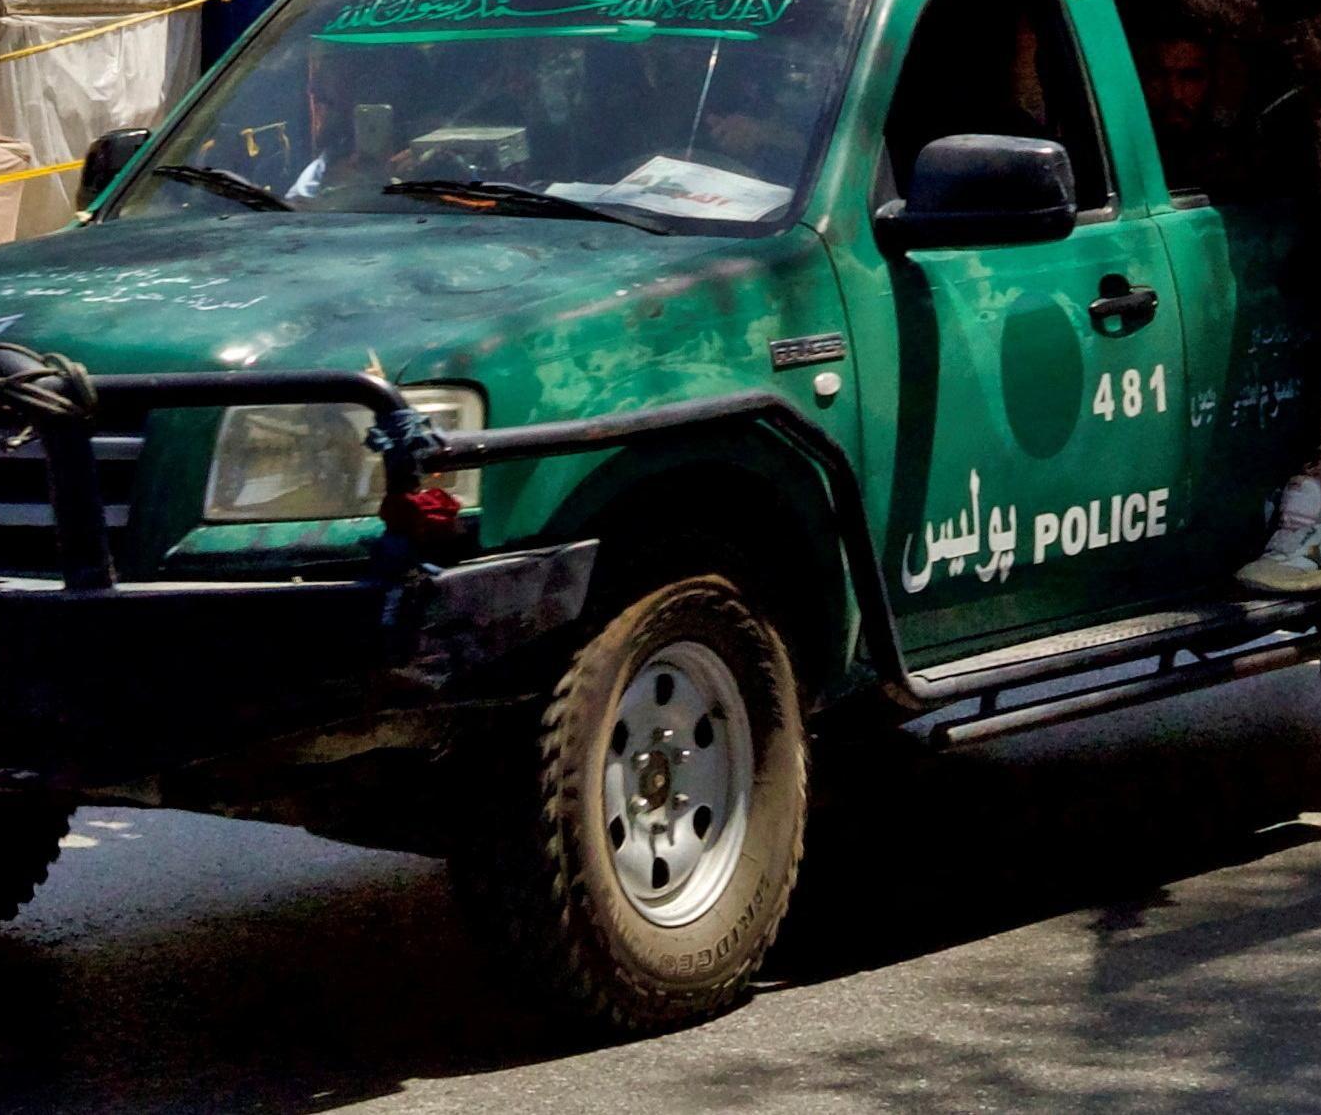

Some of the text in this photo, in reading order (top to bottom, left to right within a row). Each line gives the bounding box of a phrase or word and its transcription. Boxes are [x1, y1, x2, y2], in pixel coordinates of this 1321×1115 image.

[1092, 363, 1168, 422] 481
[901, 467, 1018, 595] پولیس
[1033, 486, 1170, 565] POLICE
